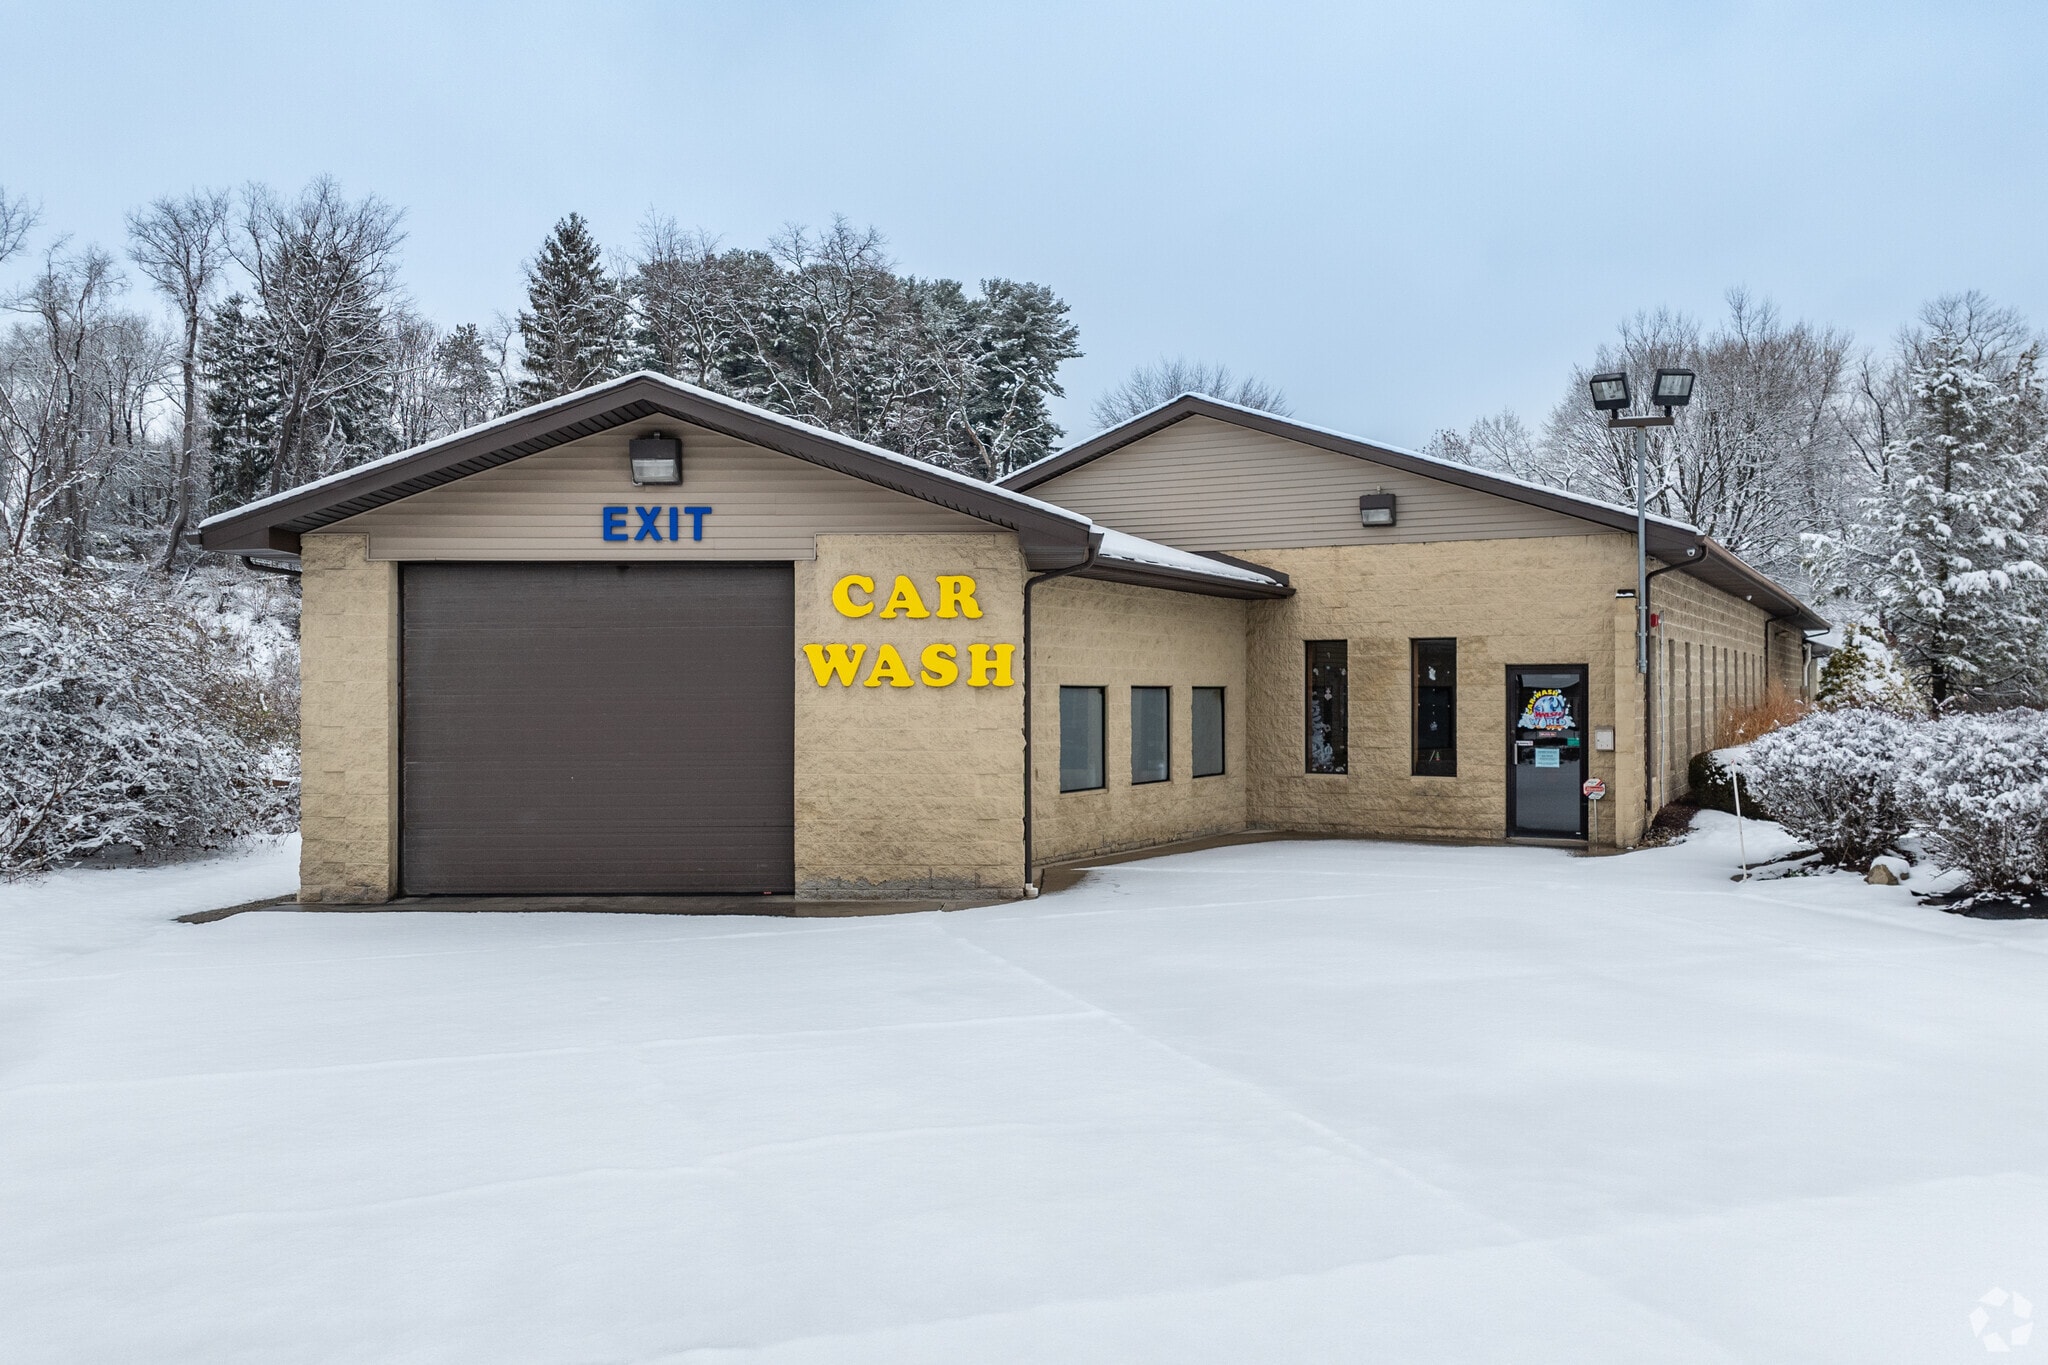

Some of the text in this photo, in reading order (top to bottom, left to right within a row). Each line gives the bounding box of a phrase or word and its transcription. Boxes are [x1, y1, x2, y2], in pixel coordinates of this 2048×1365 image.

[602, 506, 712, 541] EXIT
[832, 574, 983, 619] CAR
[803, 643, 1015, 687] WASH
[1534, 689, 1559, 699] WASH
